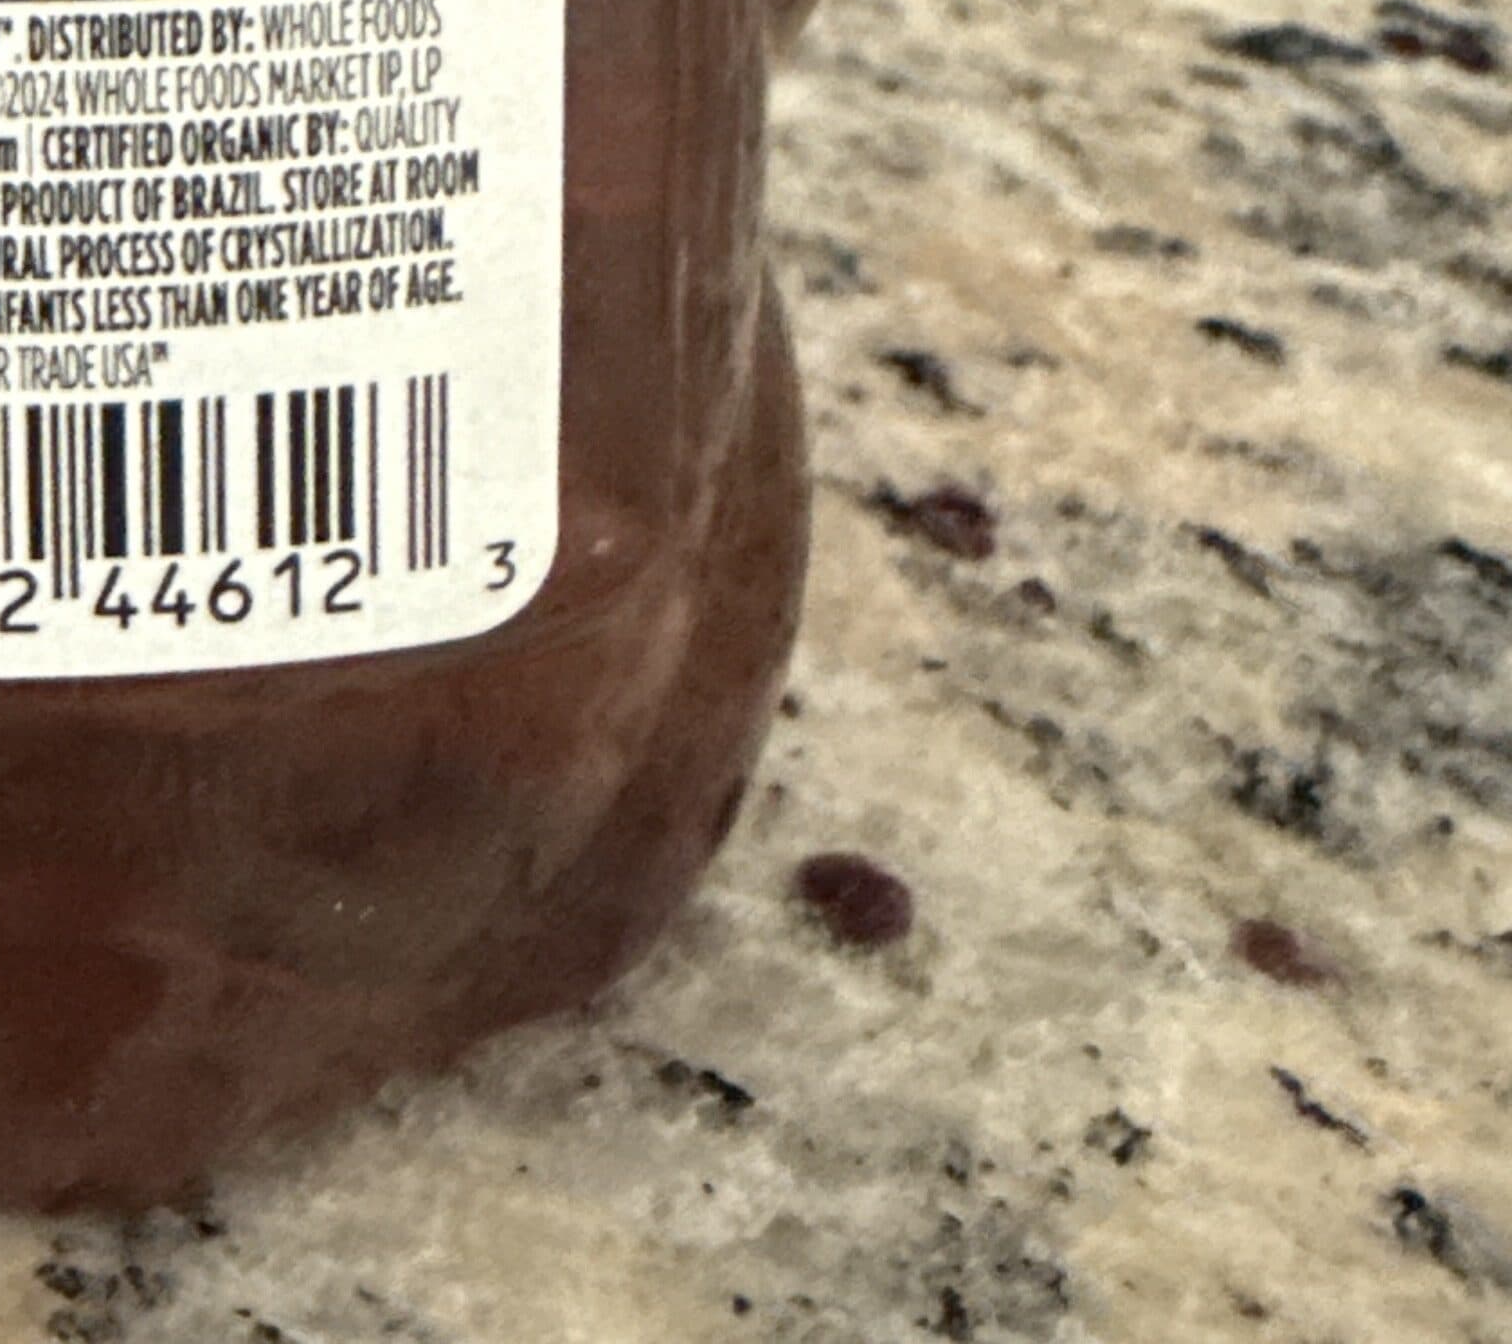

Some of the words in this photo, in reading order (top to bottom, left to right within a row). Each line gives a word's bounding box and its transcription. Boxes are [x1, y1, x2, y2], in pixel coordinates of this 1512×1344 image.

[29, 10, 203, 61] DISTRIBUTED
[210, 7, 255, 56] BY:
[74, 67, 169, 116] WHOLE
[176, 60, 261, 112] FOODS
[267, 51, 370, 106] MARKET
[411, 46, 443, 96] LP
[42, 120, 174, 172] CERTIFIED
[180, 113, 300, 166] ORGANIC
[306, 111, 351, 158] BY:
[354, 97, 461, 153] QUALITY
[2, 179, 125, 226] PRODUCT
[133, 175, 167, 223] OF
[172, 171, 277, 222] BRAZIL.
[283, 162, 364, 213] STORE
[369, 159, 397, 205] AT
[405, 149, 481, 201] ROOM
[59, 230, 174, 280] PROCESS
[181, 226, 216, 275] OF
[219, 206, 455, 272] CRYSTALLIZATION.
[92, 285, 152, 333] LESS
[159, 280, 229, 328] THAN
[236, 278, 289, 324] ONE
[295, 271, 363, 320] YEAR
[369, 265, 401, 311] OF
[406, 258, 464, 306] AGE.
[17, 343, 95, 390] TRADE
[92, 547, 363, 629] 44612
[484, 539, 517, 592] 3
